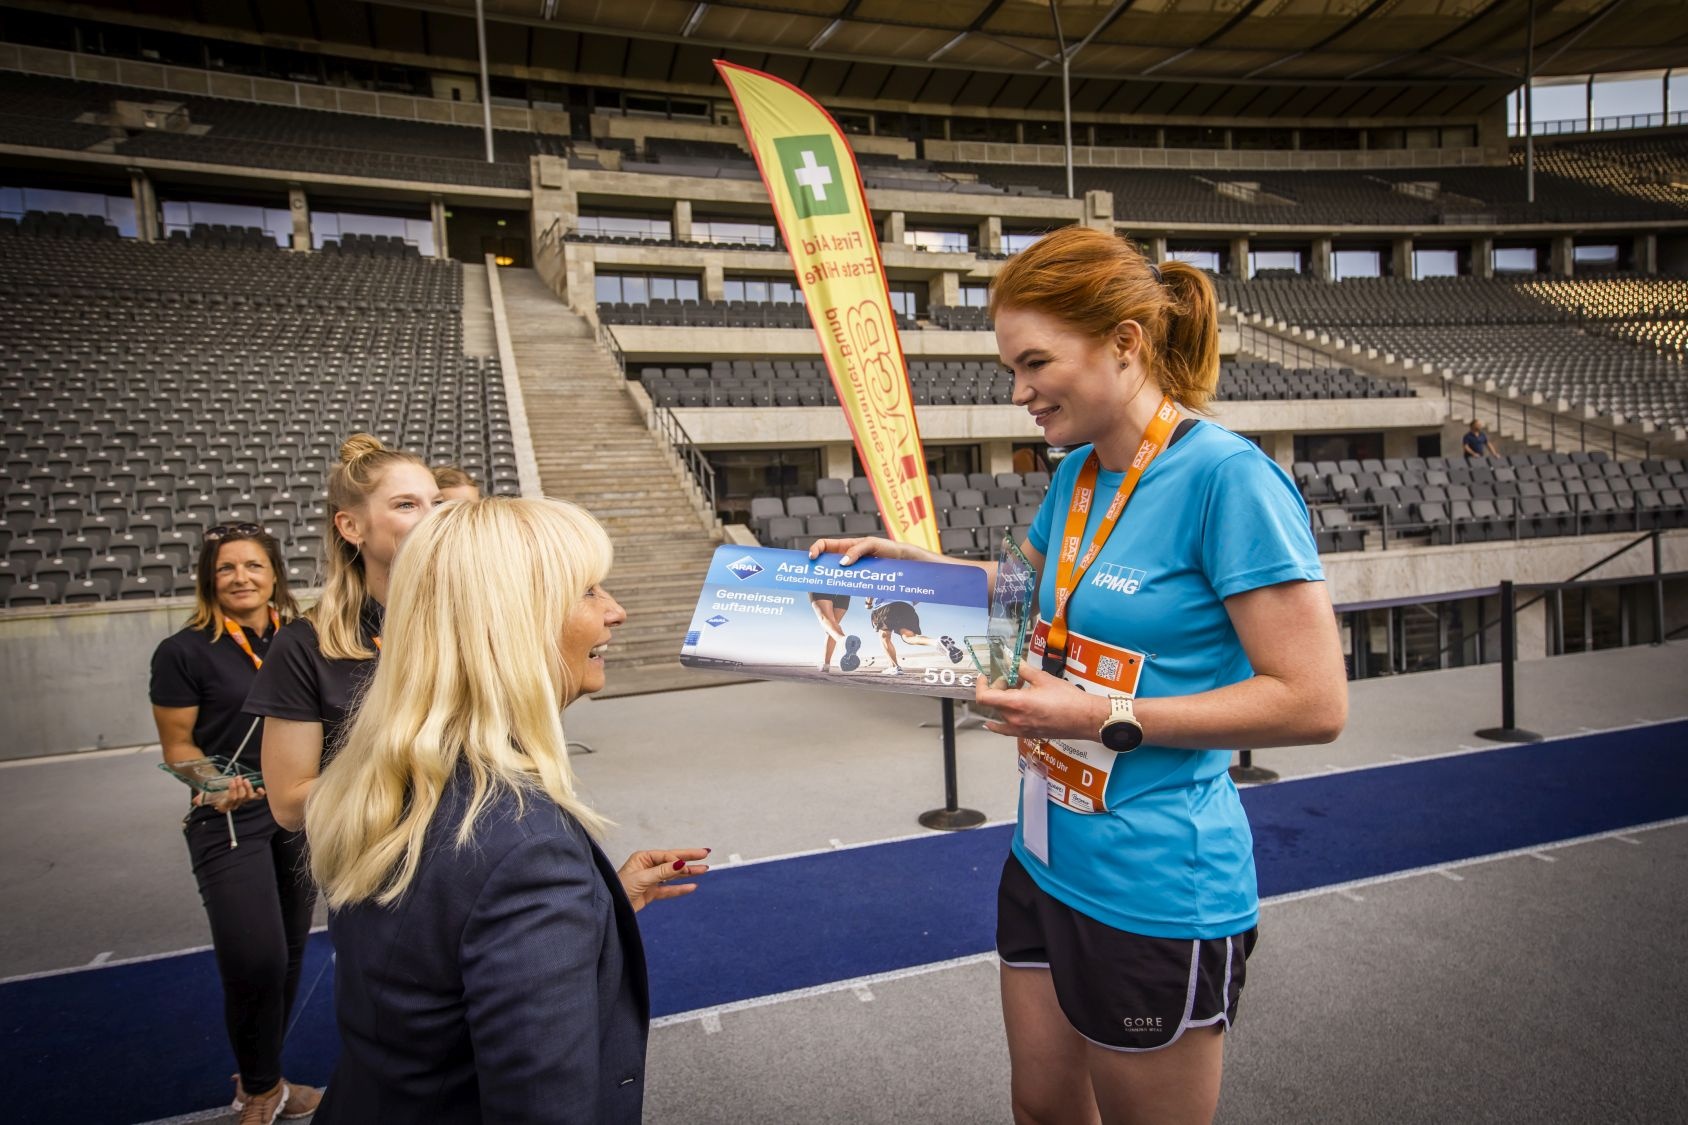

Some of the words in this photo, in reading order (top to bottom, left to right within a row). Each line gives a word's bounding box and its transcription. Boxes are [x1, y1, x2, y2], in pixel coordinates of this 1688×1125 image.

[1132, 440, 1152, 469] DAK
[1078, 488, 1091, 513] DAK
[777, 562, 808, 575] Aral
[775, 574, 824, 586] Gutschein
[826, 578, 874, 591] Einkaufen
[877, 584, 895, 593] und
[899, 585, 935, 596] Tanken
[1091, 572, 1138, 595] KPMG
[716, 589, 795, 605] Gemeinsam
[712, 601, 784, 616] auftanken!
[1081, 769, 1093, 787] D
[1123, 1017, 1163, 1027] GORE
